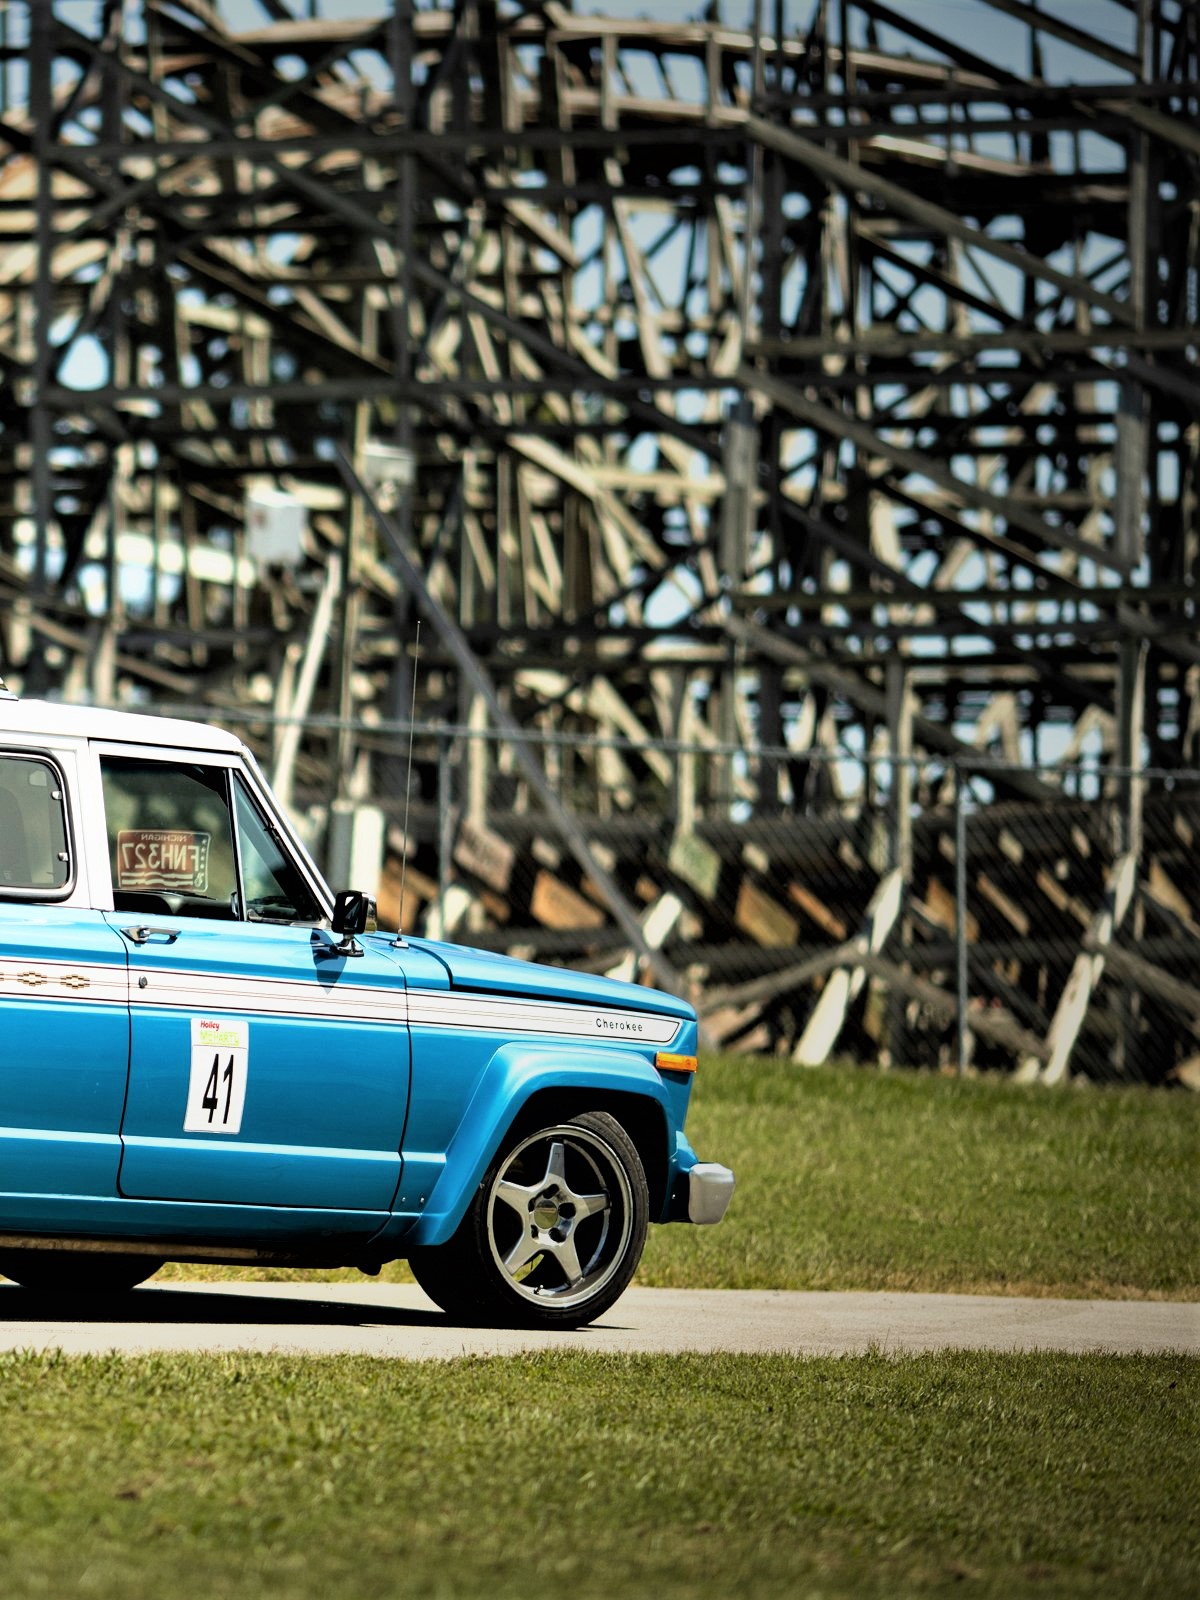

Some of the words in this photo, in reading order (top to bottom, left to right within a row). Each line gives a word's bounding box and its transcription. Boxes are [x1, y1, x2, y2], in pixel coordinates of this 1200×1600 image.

[200, 1020, 220, 1031] Holley
[595, 1018, 643, 1032] Cherokee
[201, 1053, 235, 1125] 41
